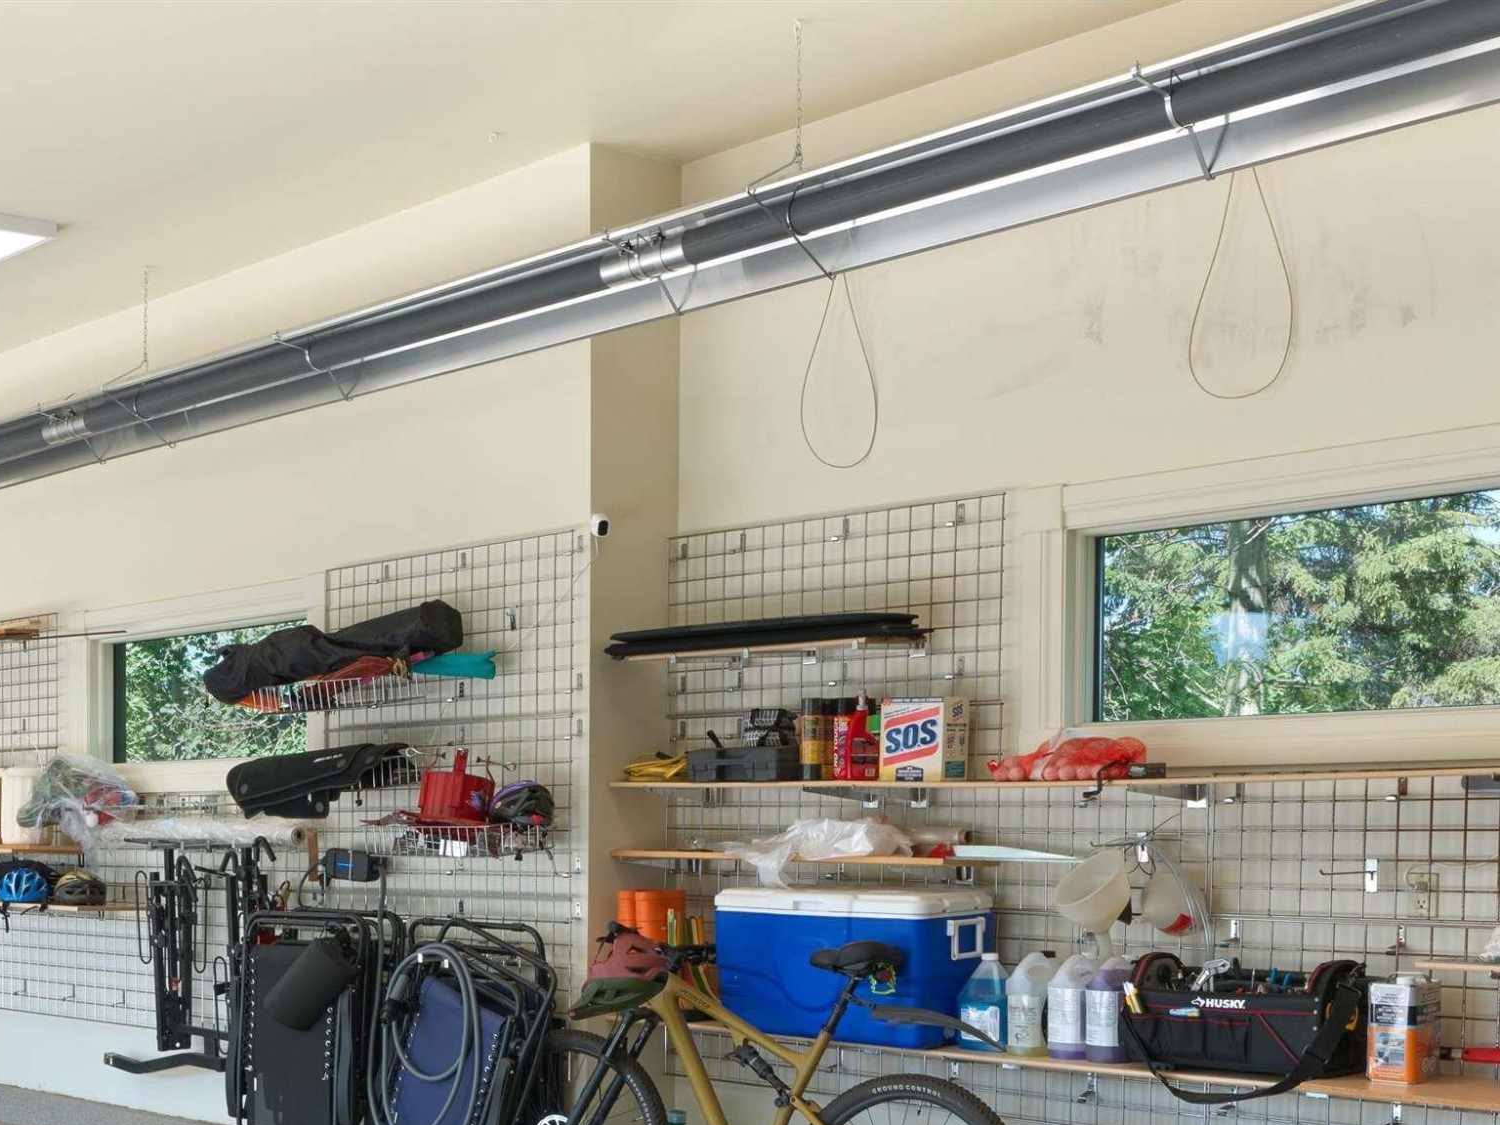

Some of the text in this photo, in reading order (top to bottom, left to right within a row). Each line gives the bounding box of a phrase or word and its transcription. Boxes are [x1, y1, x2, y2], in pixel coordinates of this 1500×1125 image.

[1205, 998, 1246, 1009] HUSKY
[871, 1084, 943, 1099] GROUND CONTROL
